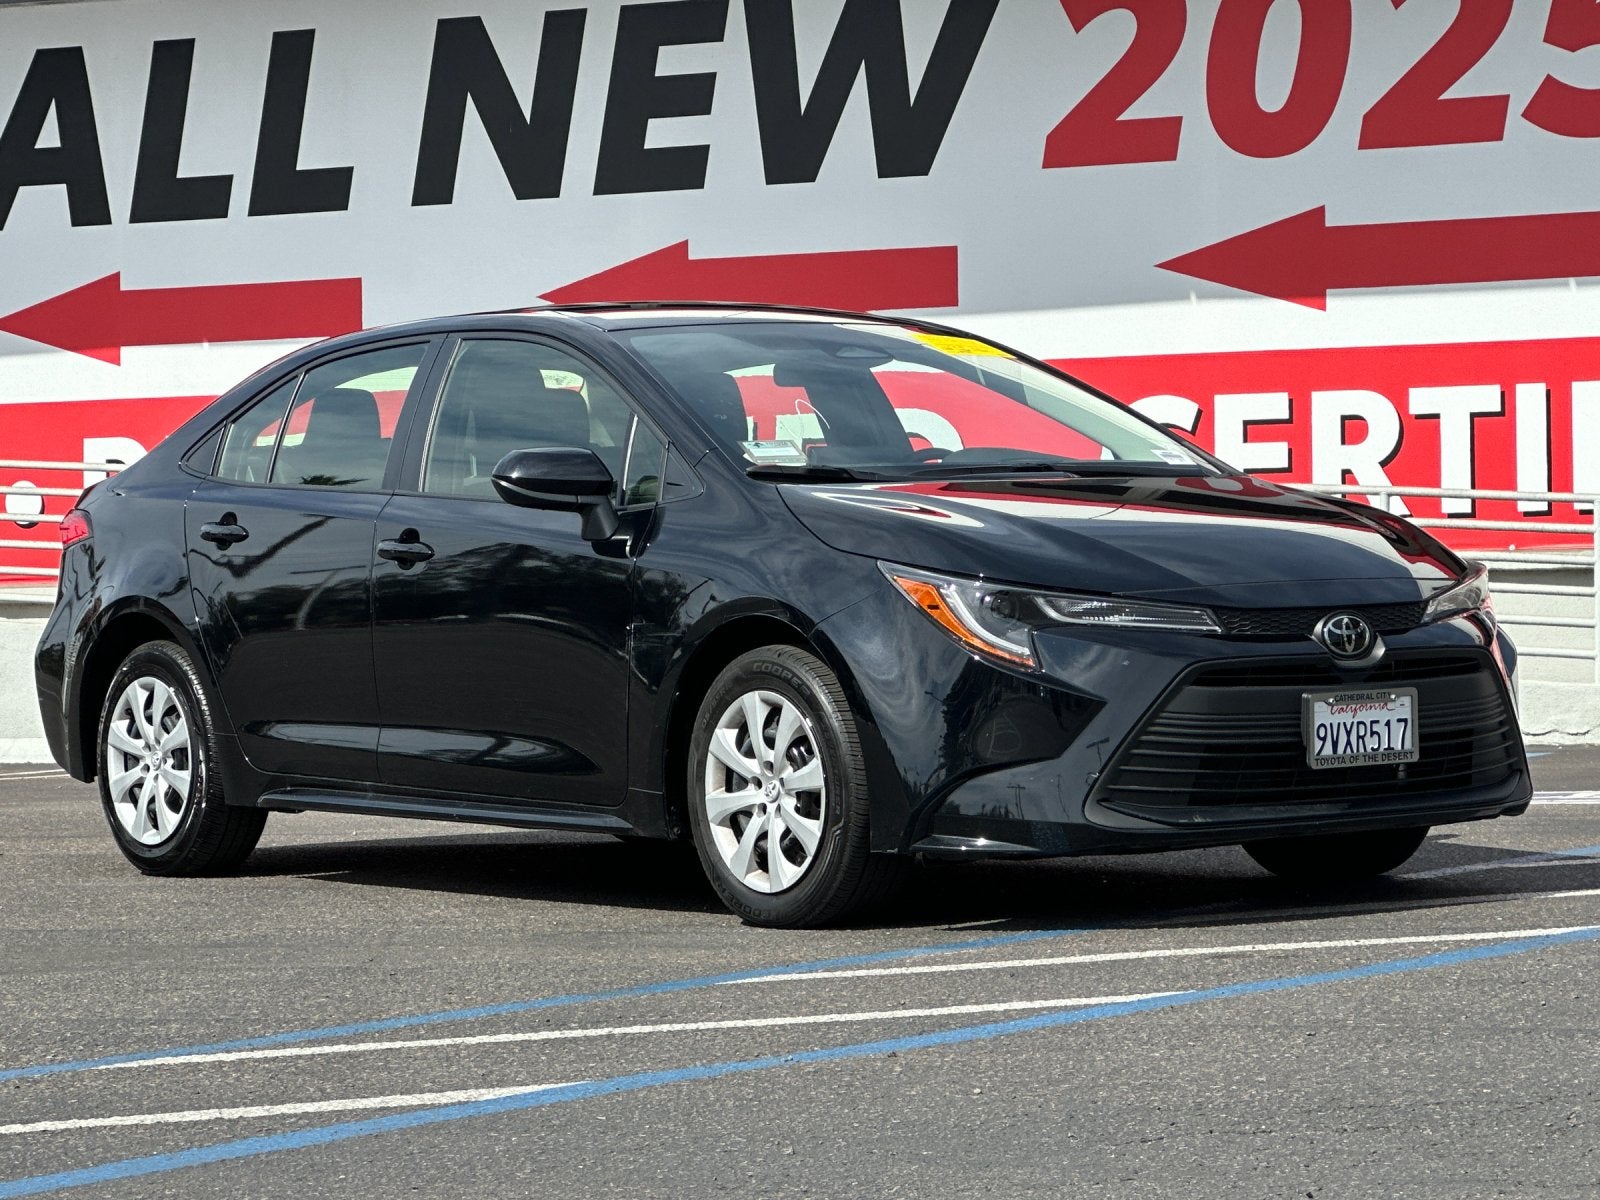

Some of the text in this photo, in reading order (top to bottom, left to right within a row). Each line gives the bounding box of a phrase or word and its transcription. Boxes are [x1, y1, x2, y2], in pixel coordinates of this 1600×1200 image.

[0, 29, 354, 230] ALL
[411, 0, 999, 206] NEW
[1334, 691, 1392, 702] CATHEDRAL CITY
[1329, 702, 1396, 718] California
[1315, 718, 1408, 756] 9VXR517
[1314, 751, 1415, 767] TOYOTA OF THE DESERT
